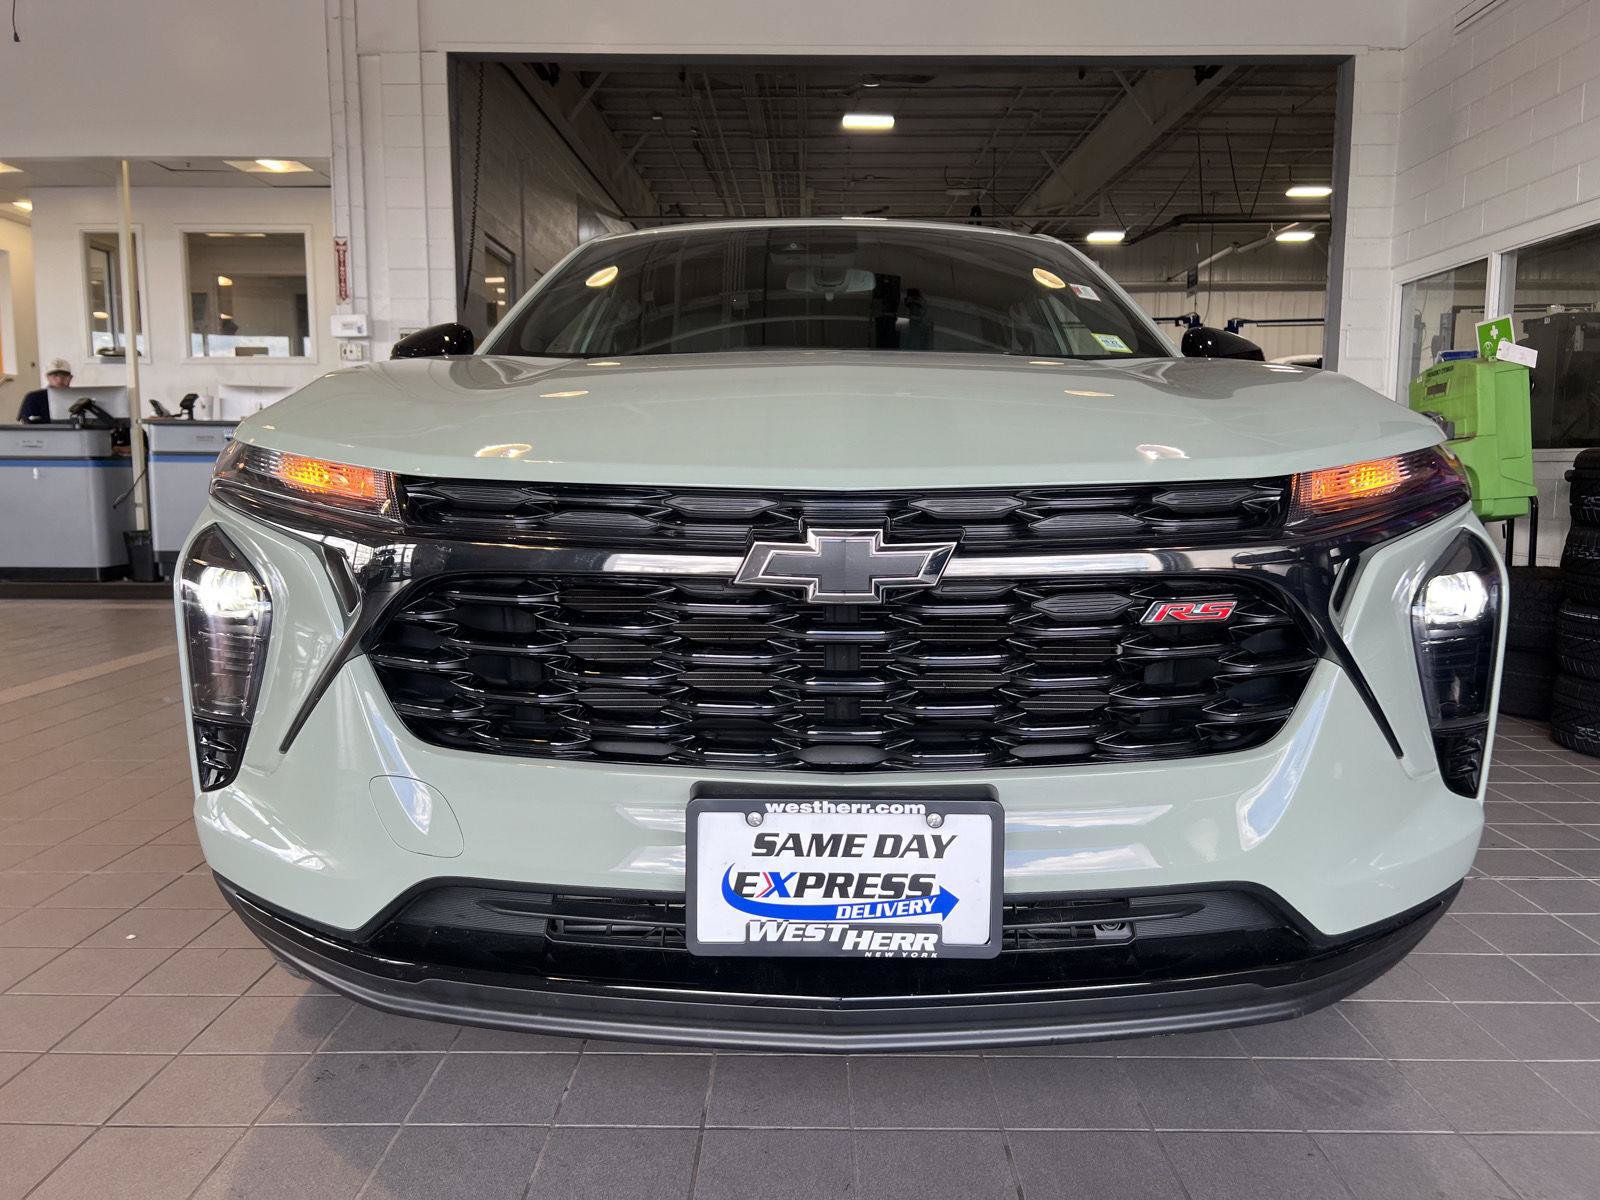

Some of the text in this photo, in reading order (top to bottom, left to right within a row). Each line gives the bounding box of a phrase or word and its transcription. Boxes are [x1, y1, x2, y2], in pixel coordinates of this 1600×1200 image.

[1151, 602, 1237, 623] RS
[765, 801, 926, 815] westherr.com
[751, 832, 959, 860] SAME DAY
[732, 871, 936, 899] EXPRESS
[835, 897, 937, 920] DELIVERY
